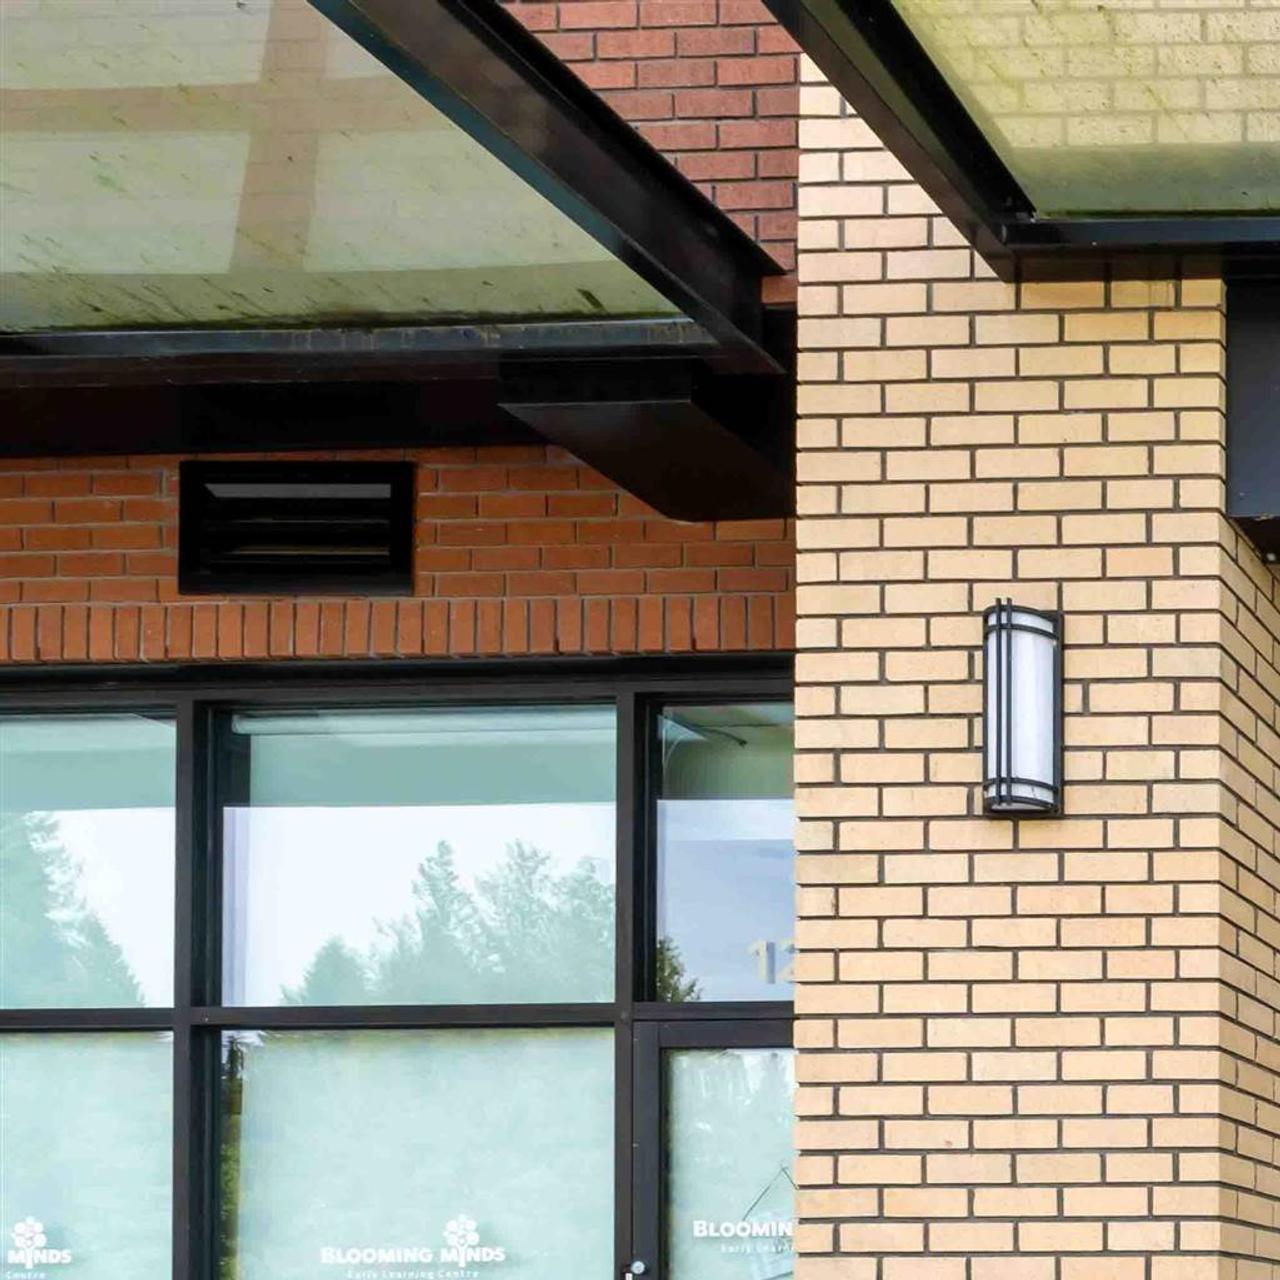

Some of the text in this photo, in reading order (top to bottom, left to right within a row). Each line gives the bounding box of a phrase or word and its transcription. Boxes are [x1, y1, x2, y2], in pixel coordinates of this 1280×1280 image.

[8, 1249, 72, 1268] MINDS
[320, 1246, 506, 1266] BLOOMING MINDS
